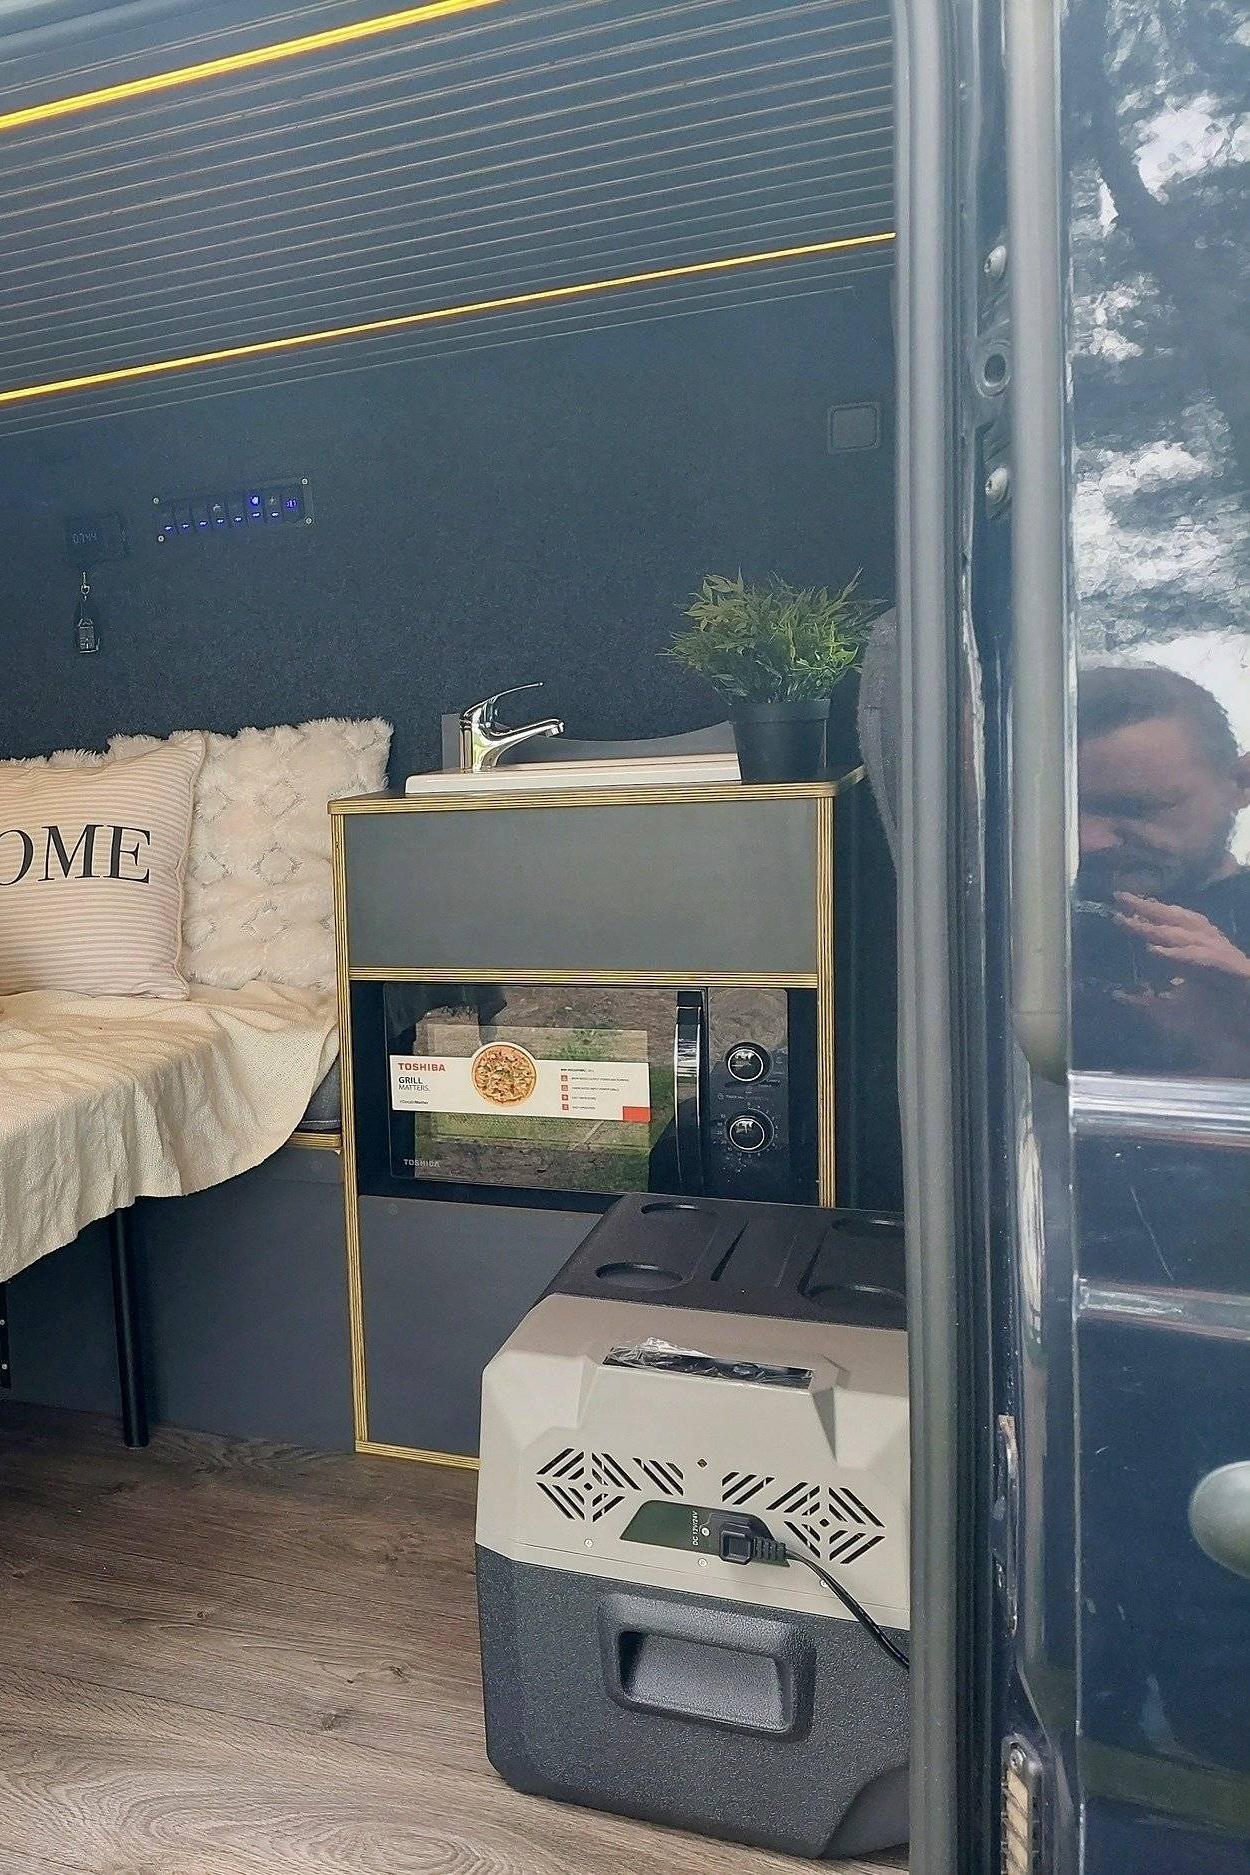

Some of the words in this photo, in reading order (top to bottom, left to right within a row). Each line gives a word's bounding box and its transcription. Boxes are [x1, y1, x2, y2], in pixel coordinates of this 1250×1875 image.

[397, 1062, 446, 1072] TOSHIBA
[398, 1076, 423, 1085] GRILL
[403, 1158, 441, 1168] TOSHIBA
[692, 1535, 699, 1546] DC
